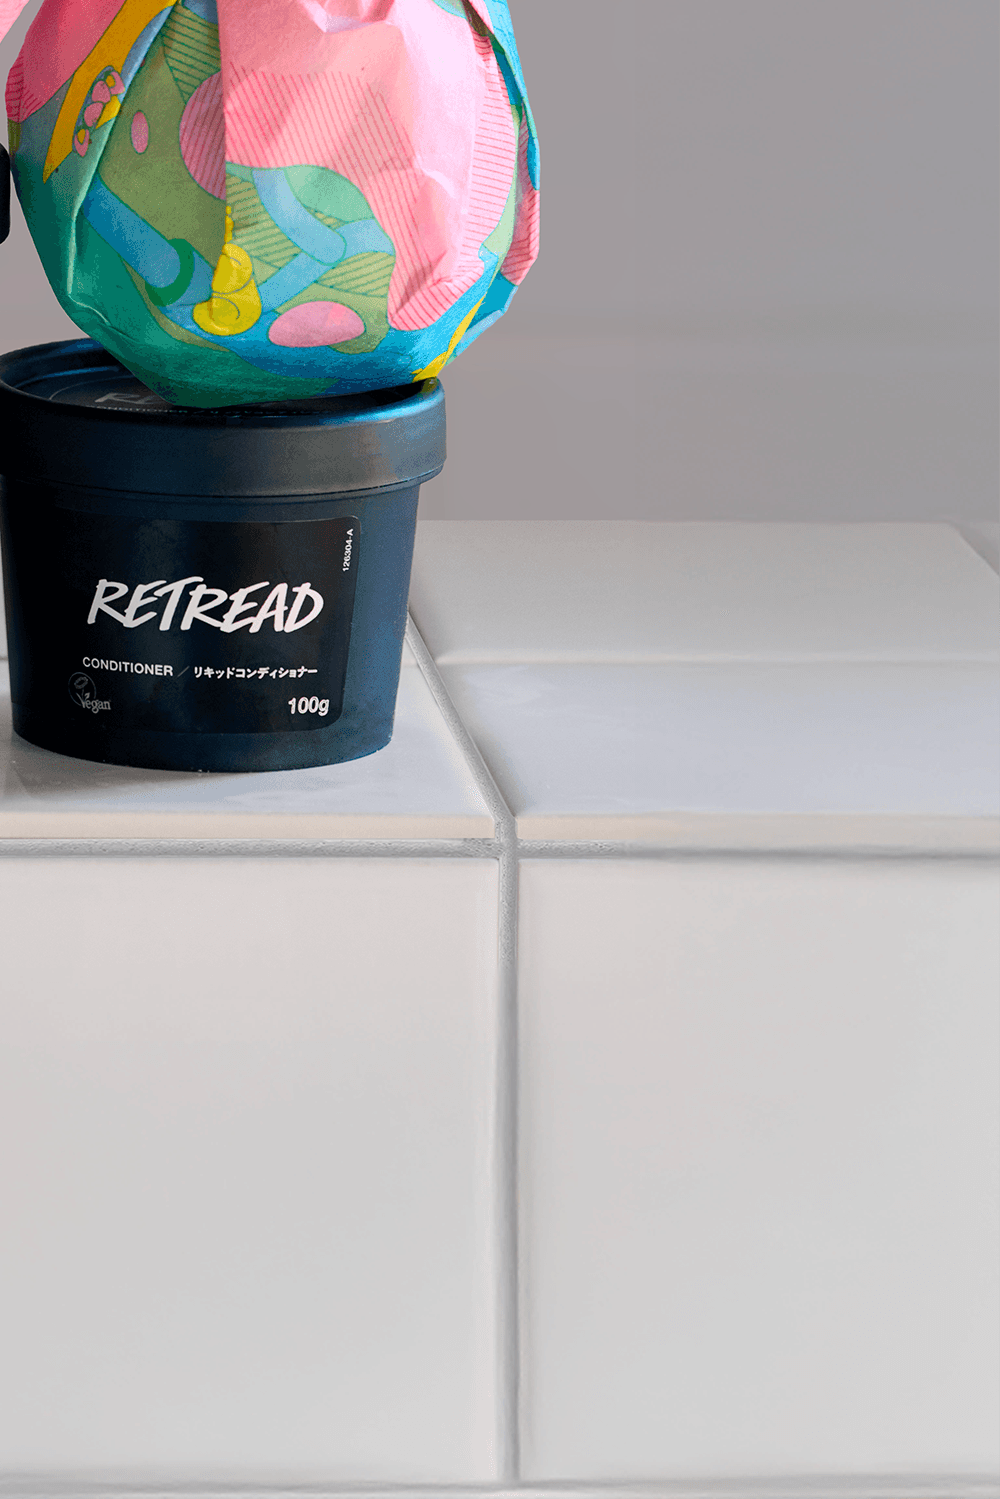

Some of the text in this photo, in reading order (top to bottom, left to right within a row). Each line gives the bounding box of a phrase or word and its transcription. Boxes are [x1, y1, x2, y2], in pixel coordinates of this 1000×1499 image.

[342, 528, 354, 572] 126304-A
[87, 576, 324, 633] RETREAD
[82, 657, 174, 677] CONDITIONER
[194, 666, 318, 679] リキッドコンディショナー
[76, 692, 111, 714] Vegan
[288, 696, 329, 716] 100g
